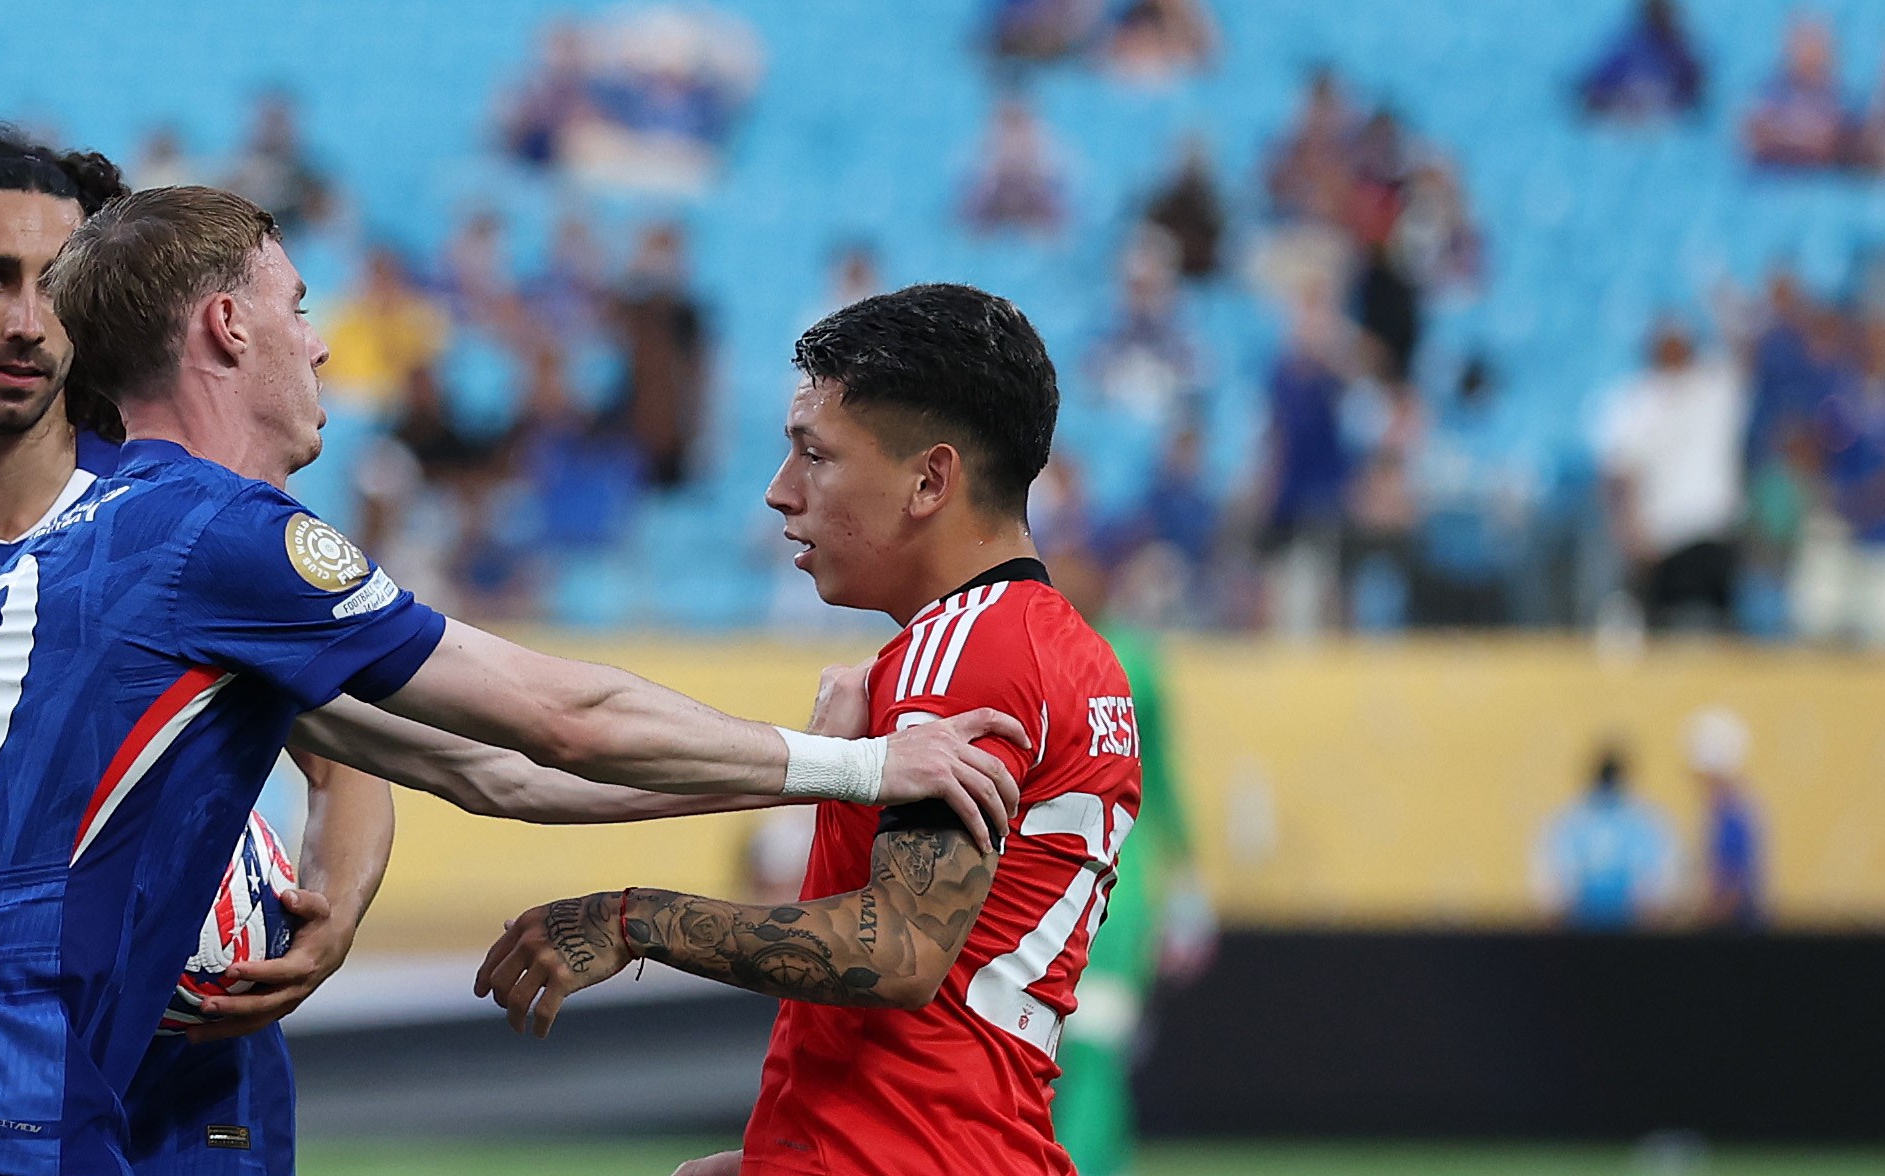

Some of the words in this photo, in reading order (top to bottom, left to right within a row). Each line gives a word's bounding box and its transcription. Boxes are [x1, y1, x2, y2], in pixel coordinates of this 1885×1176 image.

[294, 520, 310, 555] WORLD
[302, 557, 330, 580] CLUB
[336, 563, 363, 586] FIFA
